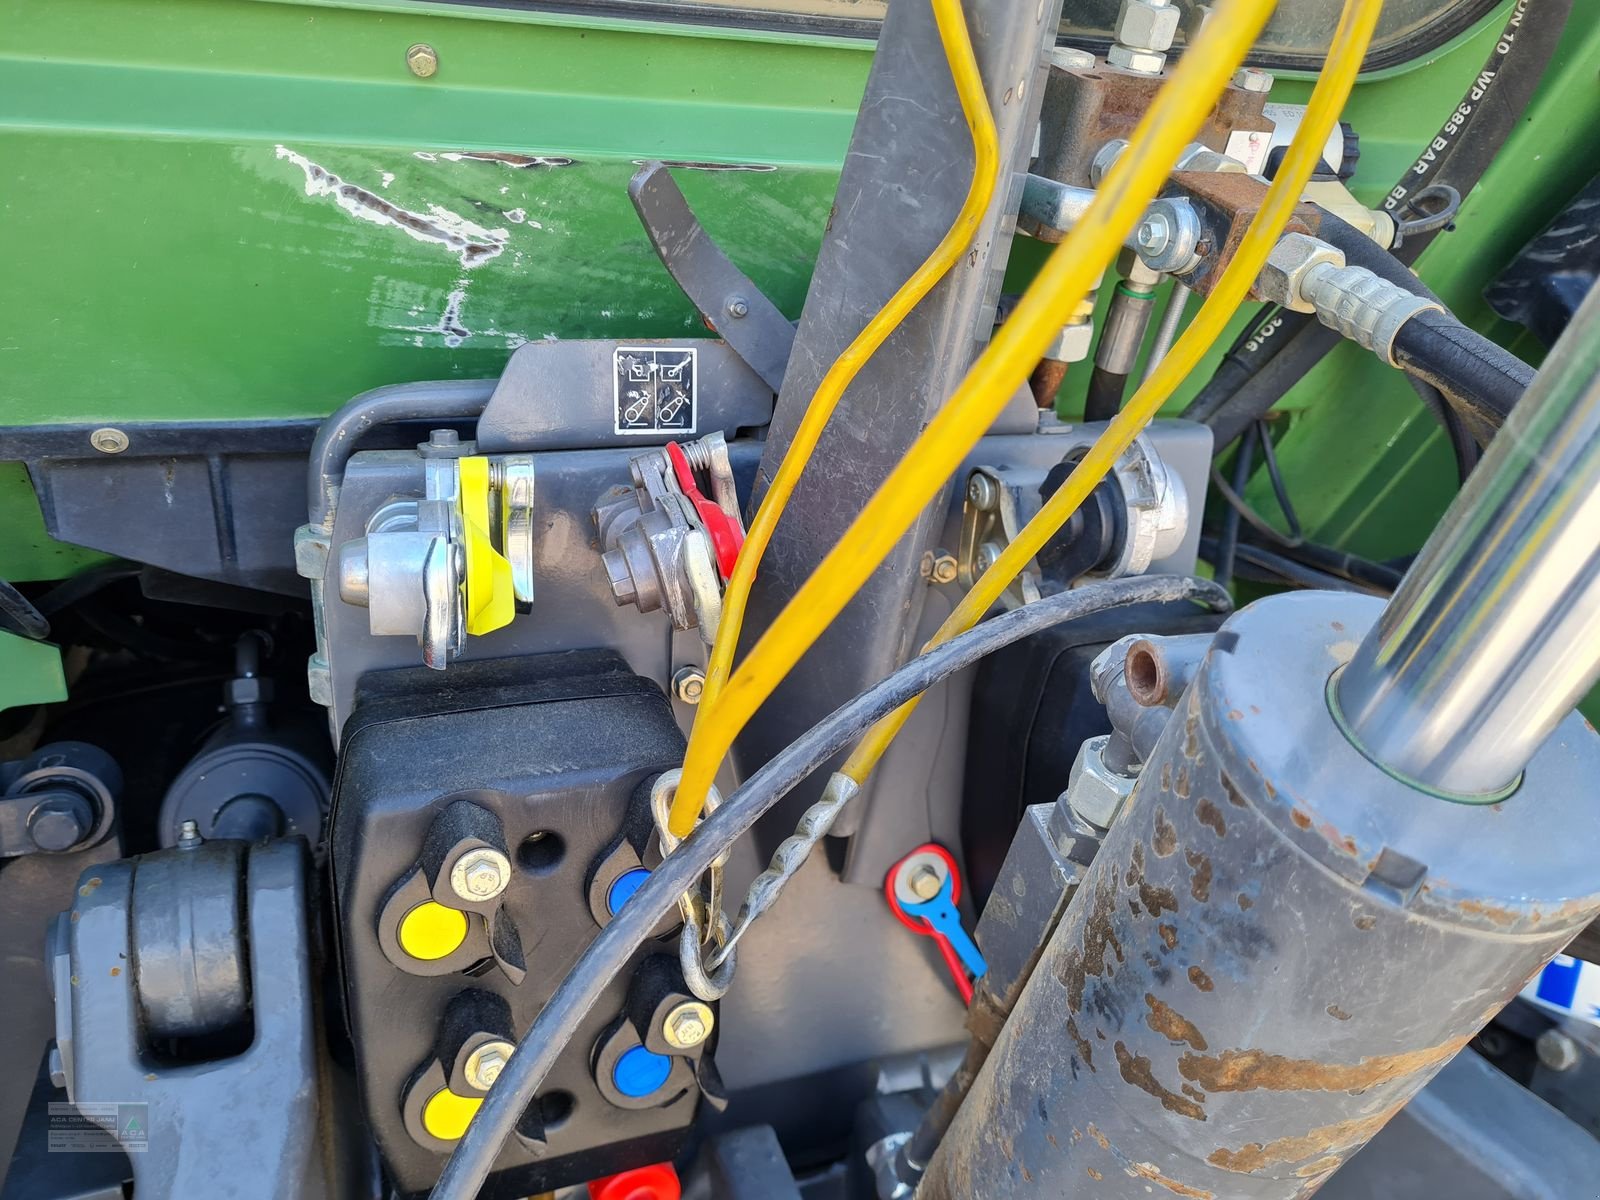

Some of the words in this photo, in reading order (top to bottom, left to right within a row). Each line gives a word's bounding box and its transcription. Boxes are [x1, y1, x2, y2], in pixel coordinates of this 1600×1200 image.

[1496, 33, 1514, 54] 10
[1471, 70, 1496, 101] WP
[1444, 102, 1471, 135] 385
[1412, 137, 1448, 175] BAR
